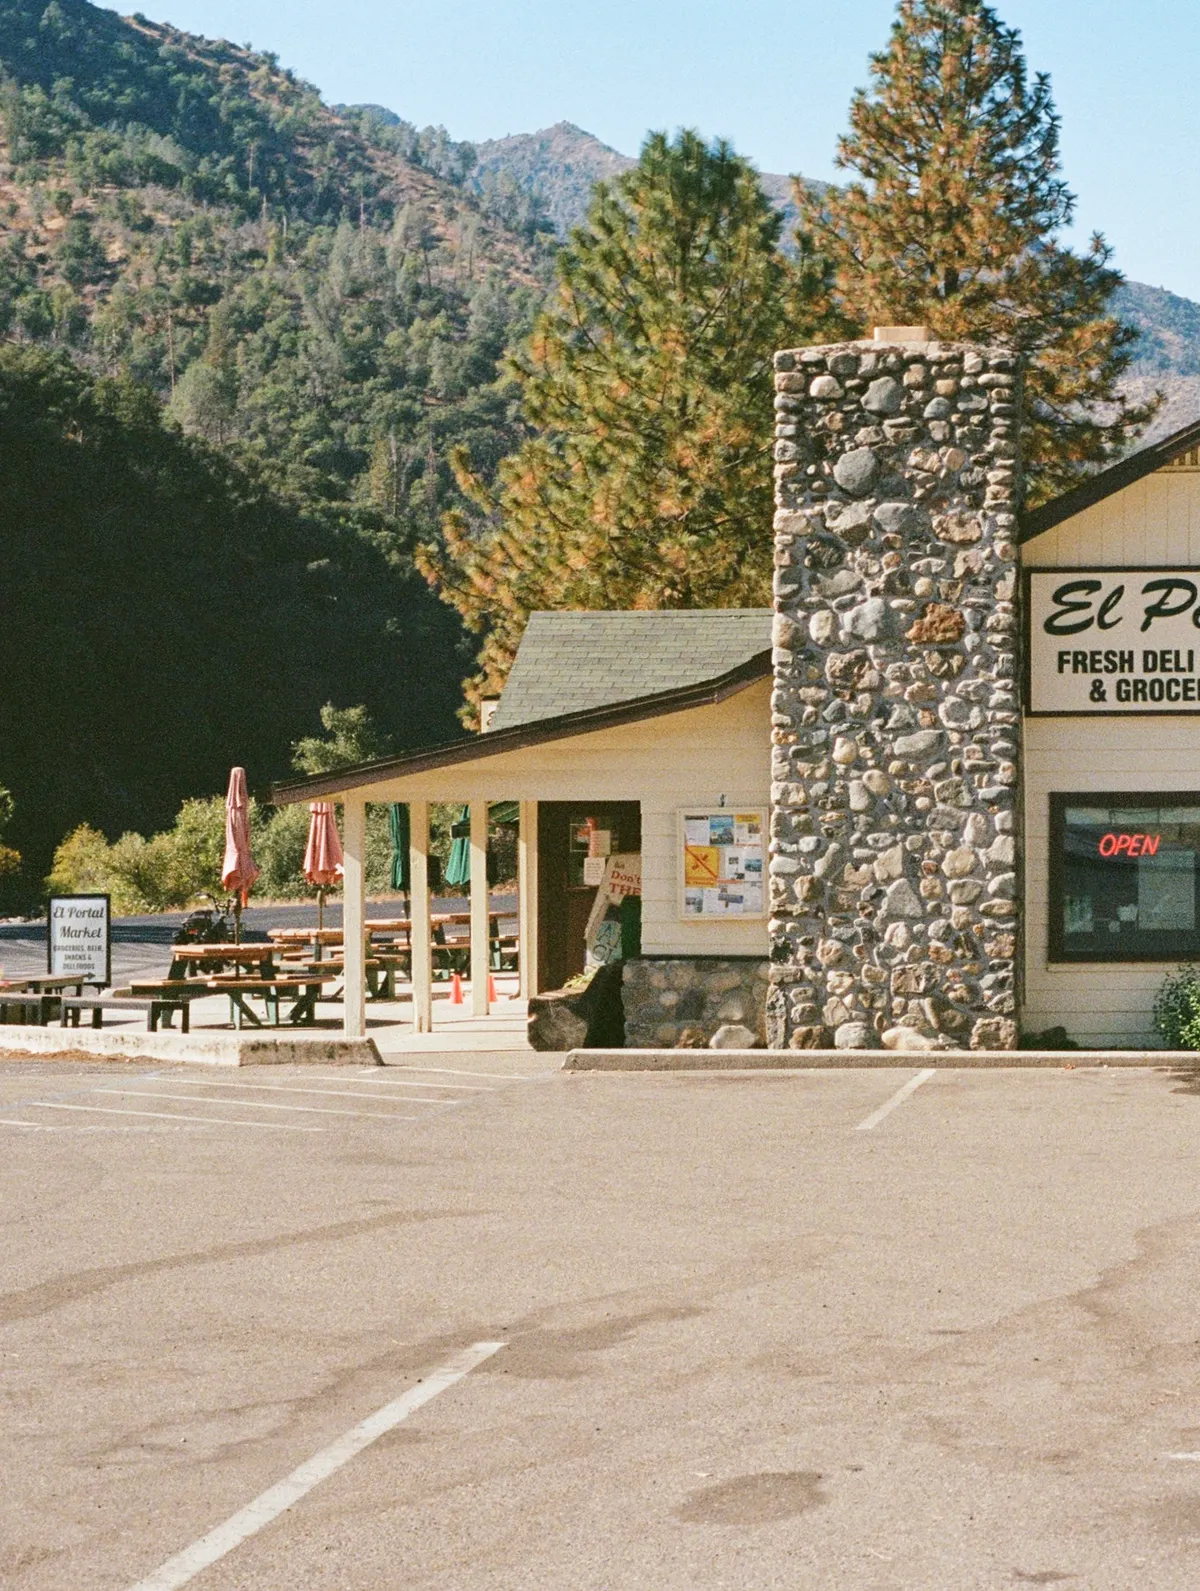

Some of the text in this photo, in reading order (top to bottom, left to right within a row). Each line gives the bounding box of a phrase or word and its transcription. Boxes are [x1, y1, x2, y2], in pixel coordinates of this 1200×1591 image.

[1043, 579, 1123, 636] El
[1057, 649, 1134, 674] FRESH
[1142, 649, 1195, 673] DELI
[1089, 678, 1107, 702] &
[1098, 833, 1161, 857] OPEN
[53, 906, 105, 919] El Portal
[60, 925, 102, 938] Market
